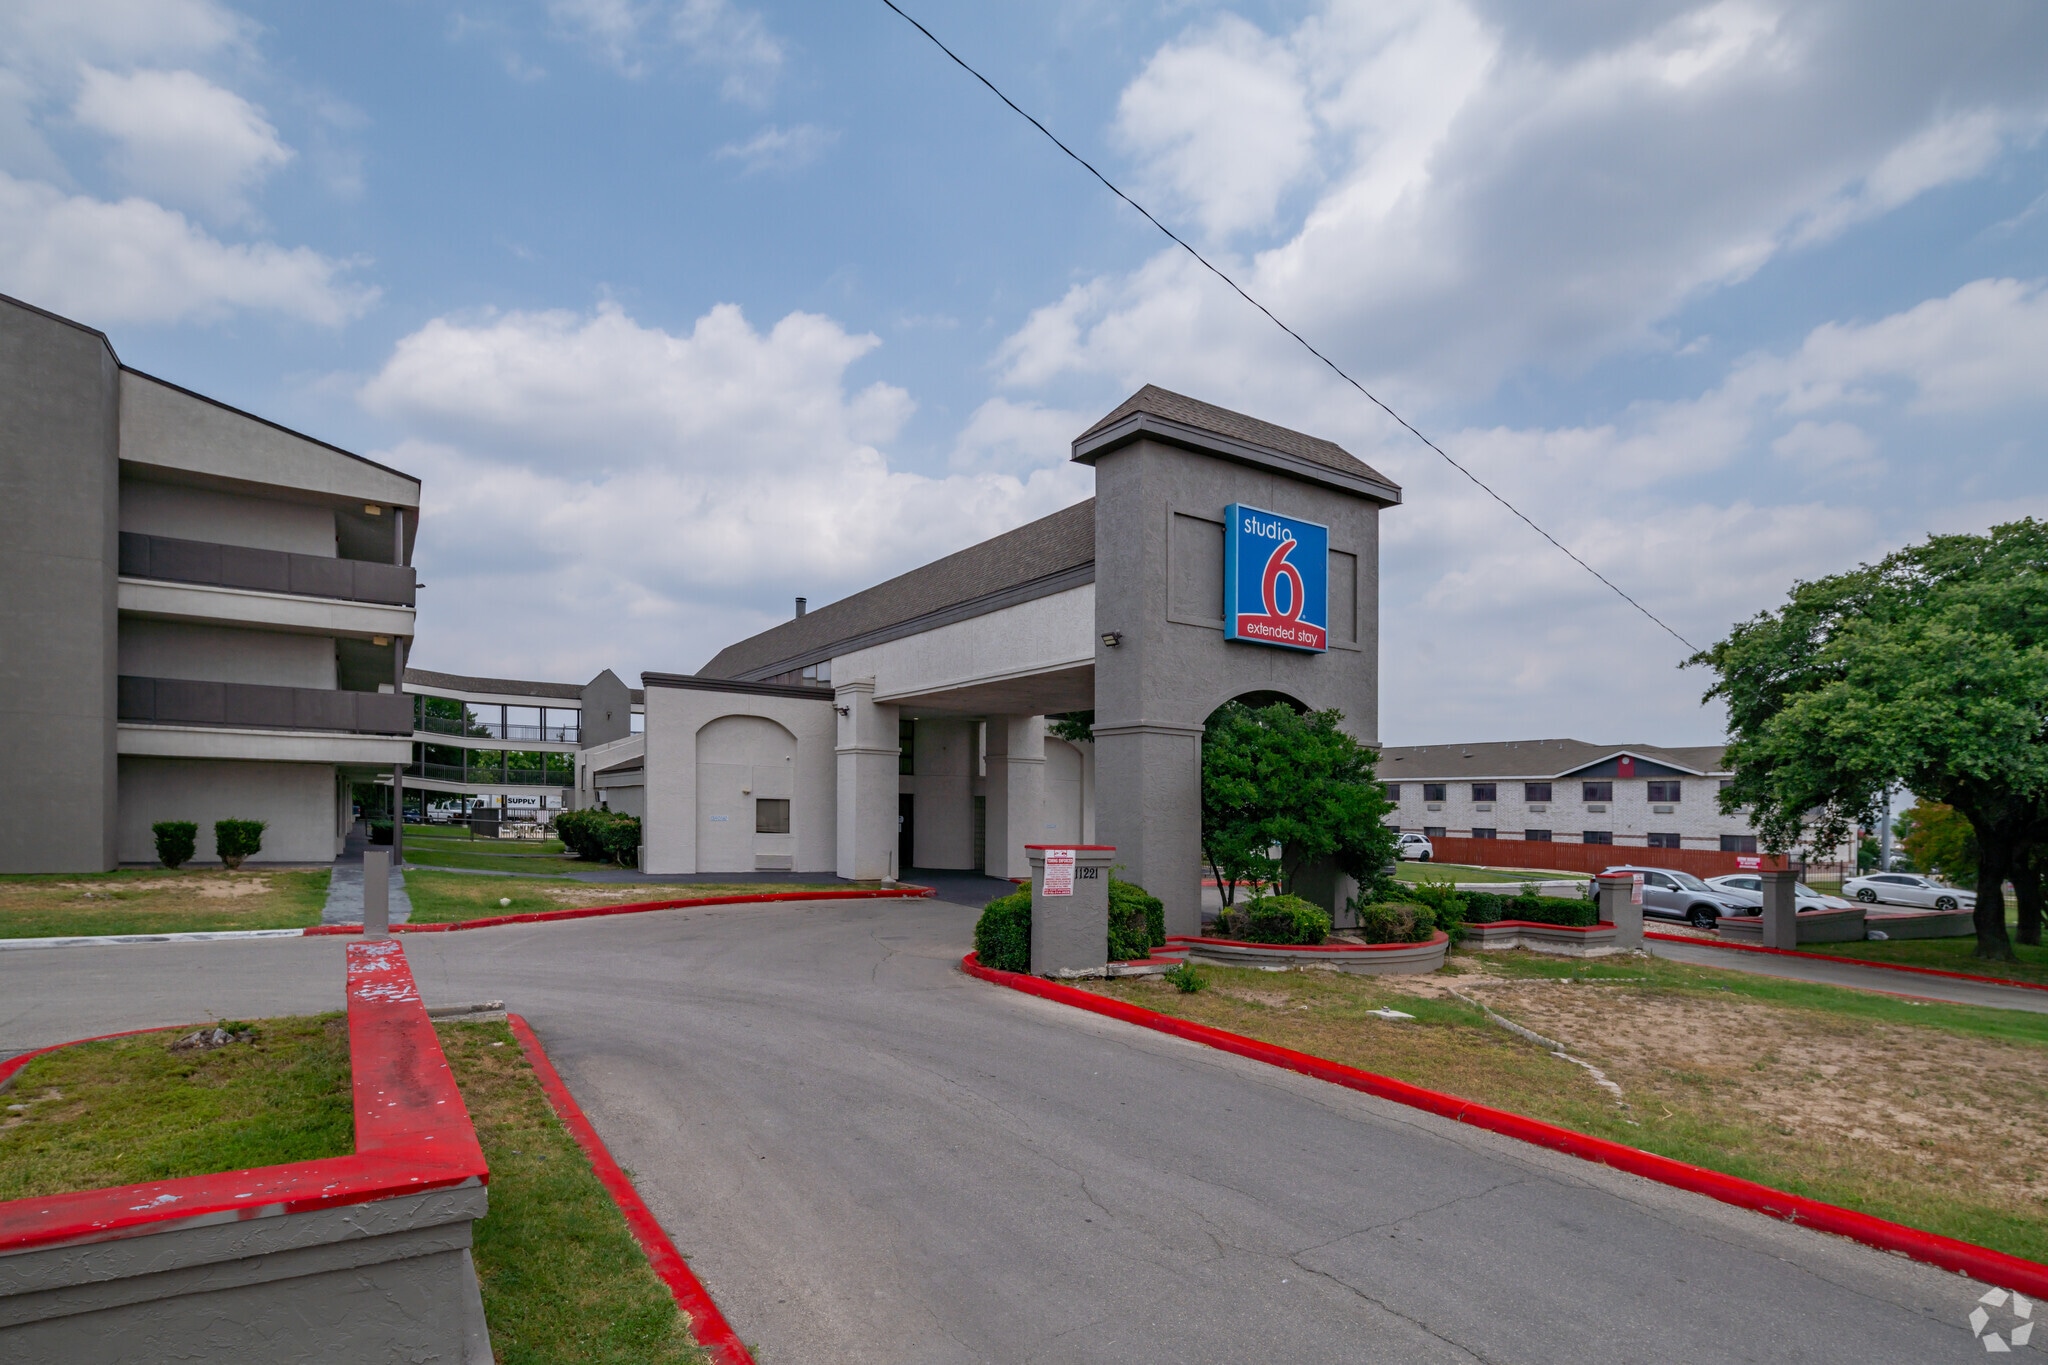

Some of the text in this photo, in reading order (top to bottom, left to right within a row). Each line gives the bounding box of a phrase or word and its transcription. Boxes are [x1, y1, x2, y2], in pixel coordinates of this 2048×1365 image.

[1244, 516, 1292, 541] studio
[1261, 538, 1305, 621] 6
[1247, 622, 1318, 646] extended stay
[507, 797, 536, 805] SUPPLY
[1075, 867, 1098, 879] 11221
